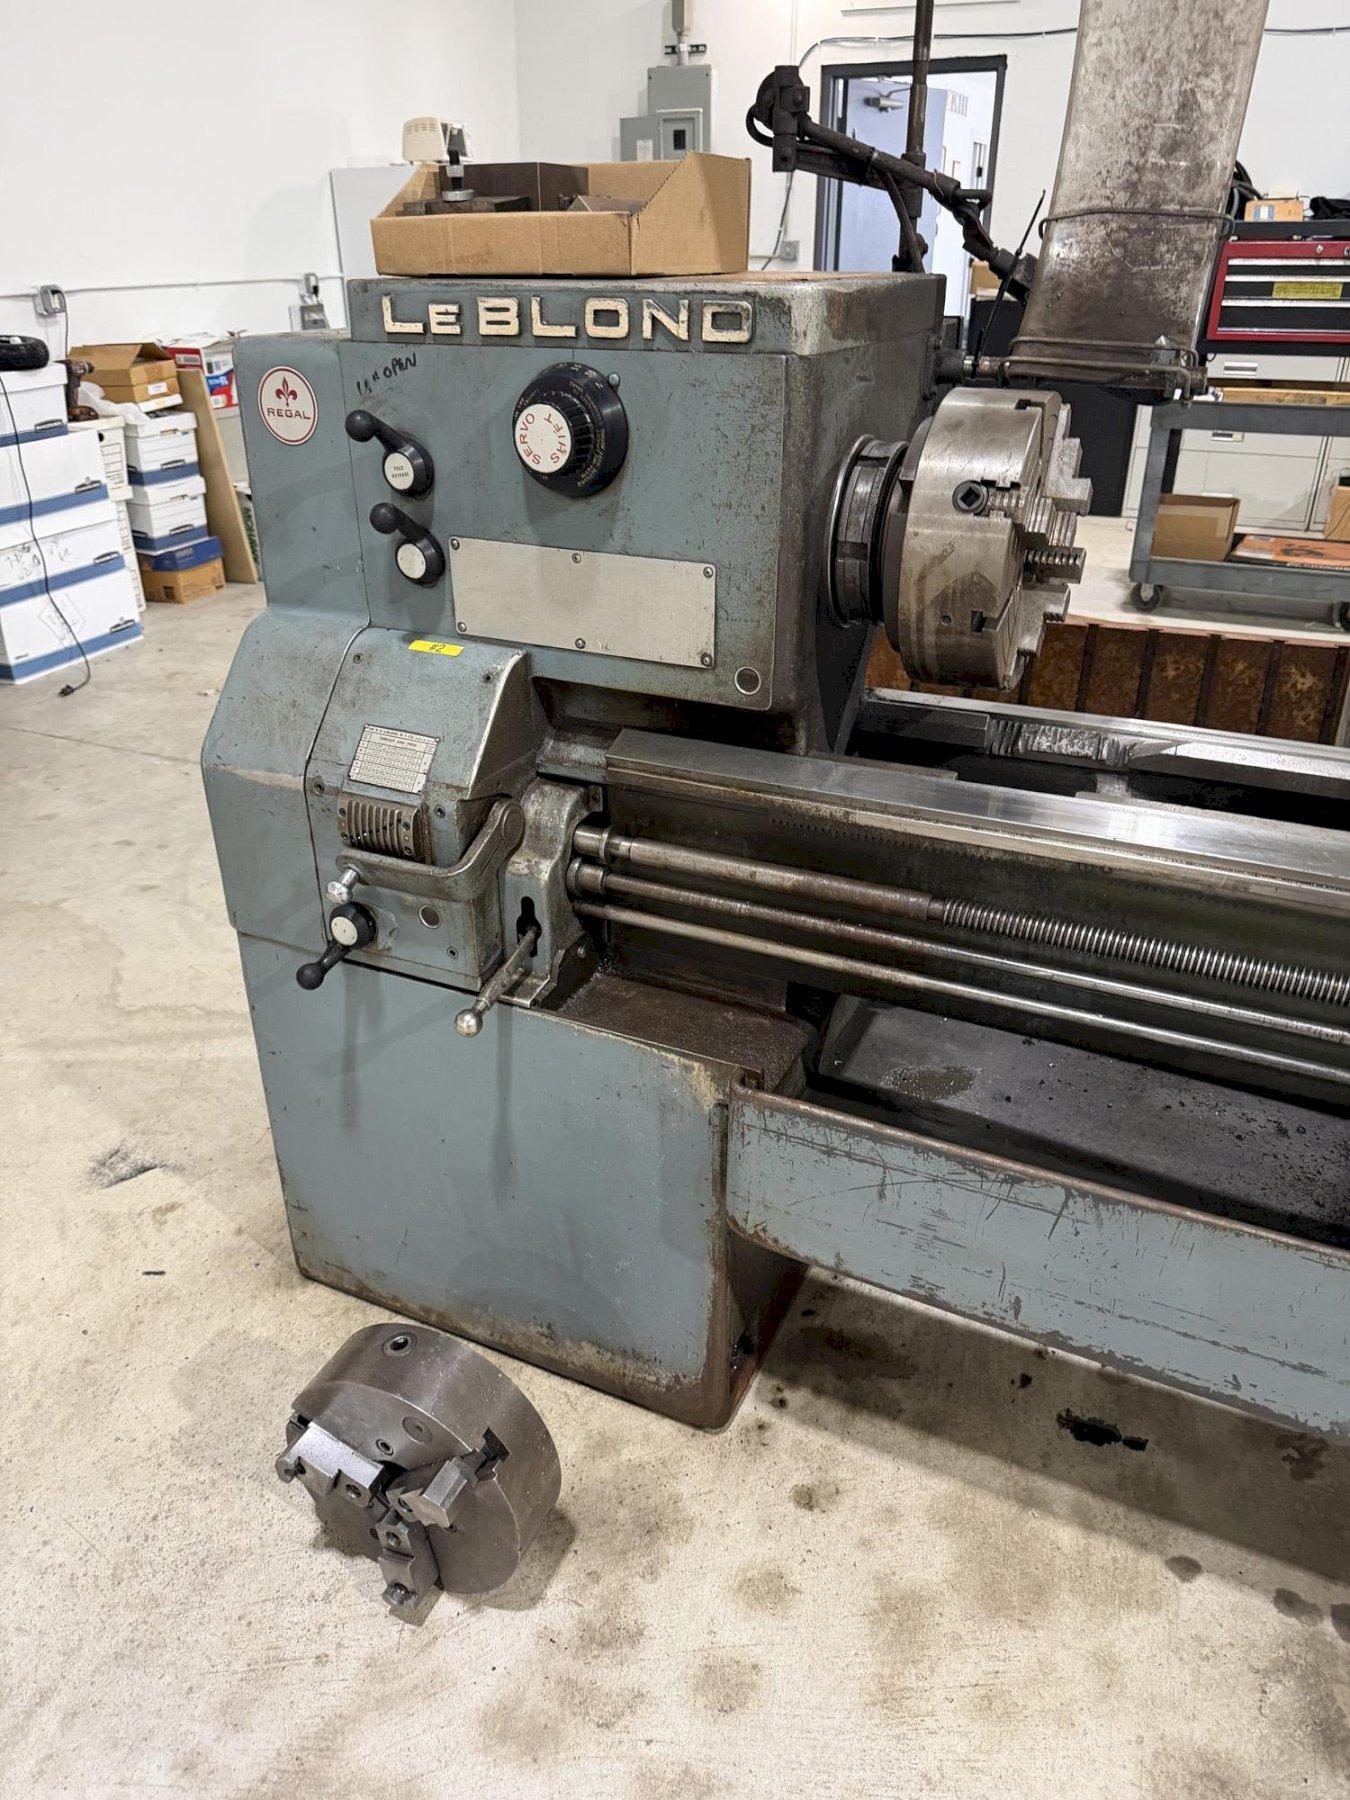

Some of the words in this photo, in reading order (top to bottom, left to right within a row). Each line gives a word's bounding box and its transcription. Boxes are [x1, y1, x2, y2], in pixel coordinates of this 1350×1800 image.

[383, 353, 416, 379] OPEN
[267, 408, 311, 419] REGAL
[519, 413, 541, 465] SERVO
[544, 413, 568, 464] SHIFT
[428, 644, 446, 653] #2
